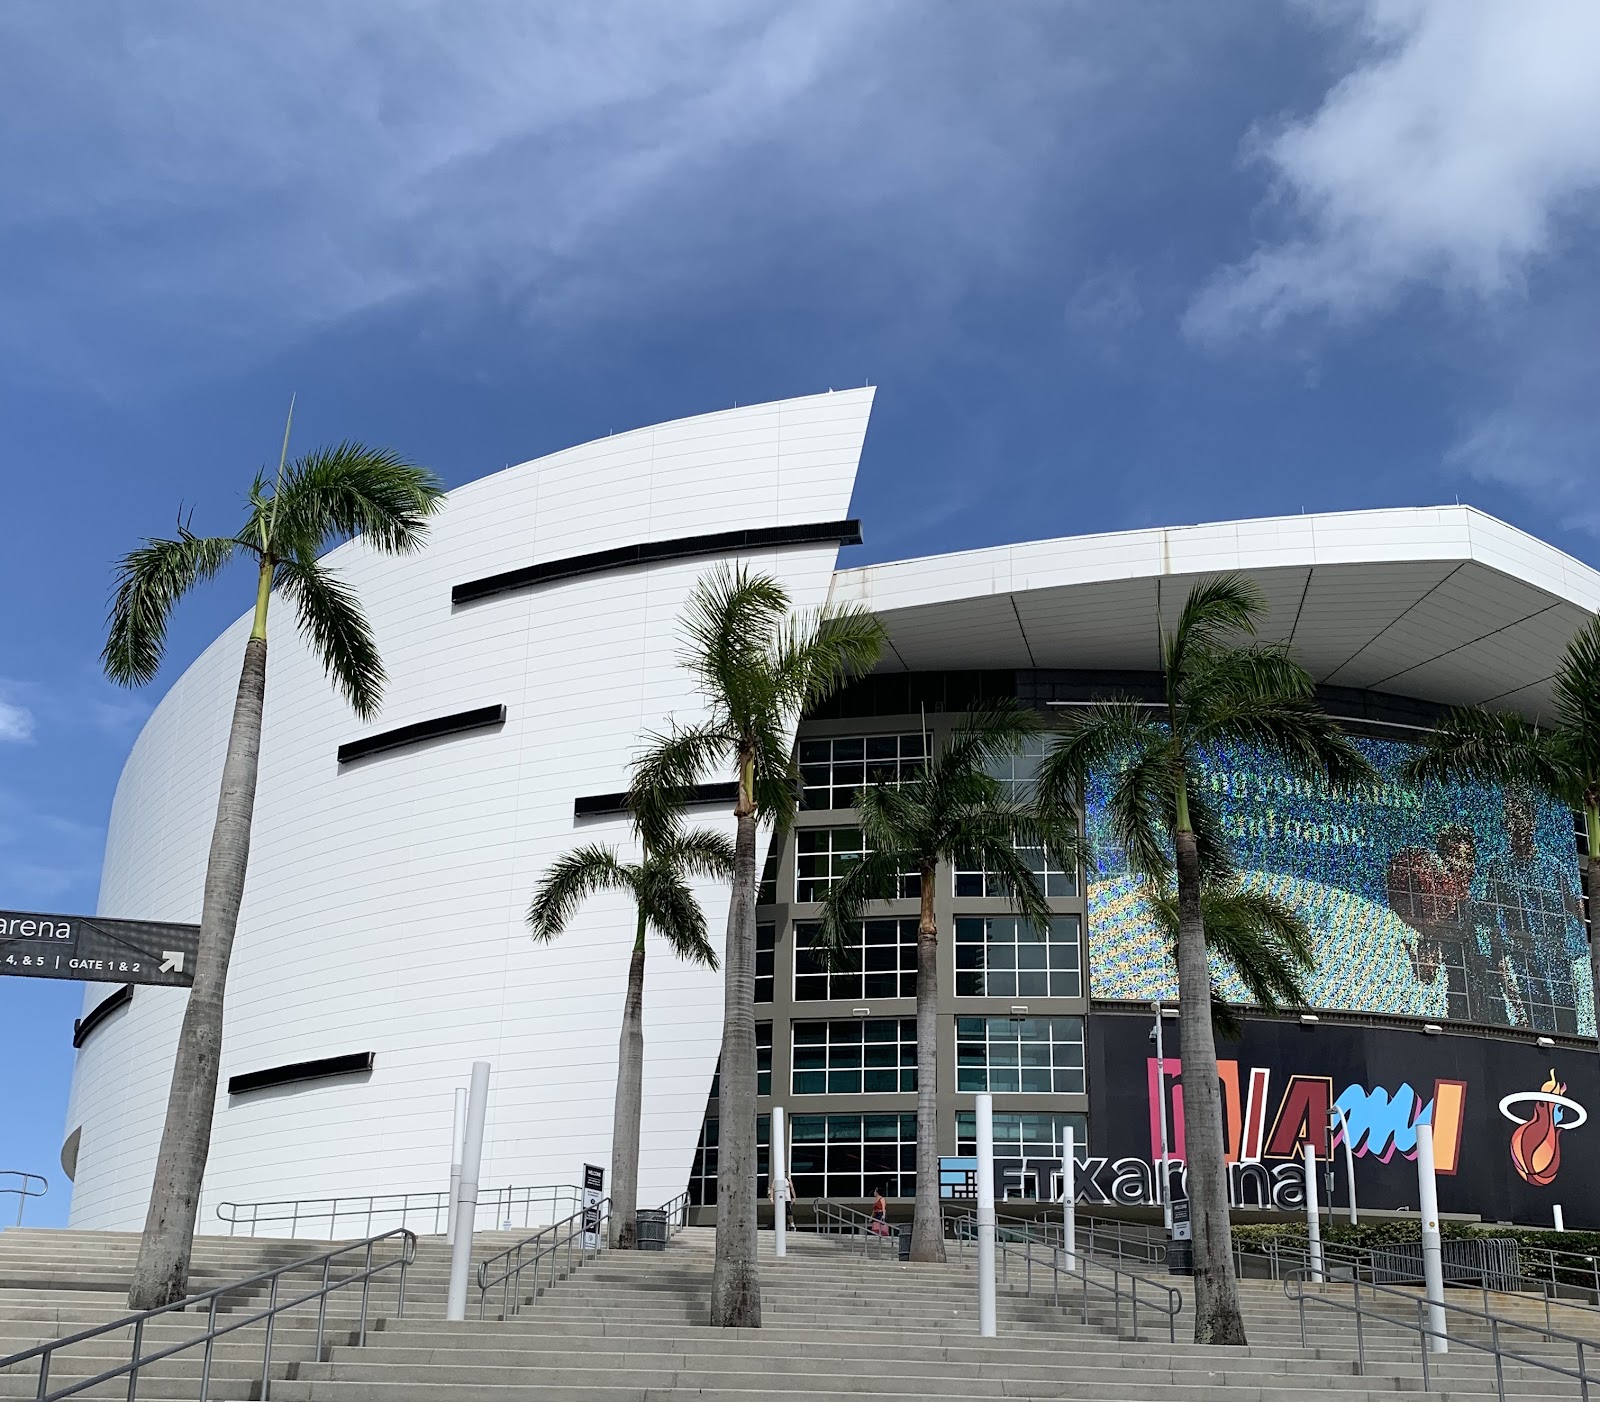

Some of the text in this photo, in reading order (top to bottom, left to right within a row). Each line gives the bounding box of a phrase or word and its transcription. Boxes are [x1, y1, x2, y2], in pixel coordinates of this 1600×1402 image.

[6, 954, 140, 972] 4, & 5 GATE 1 & 2
